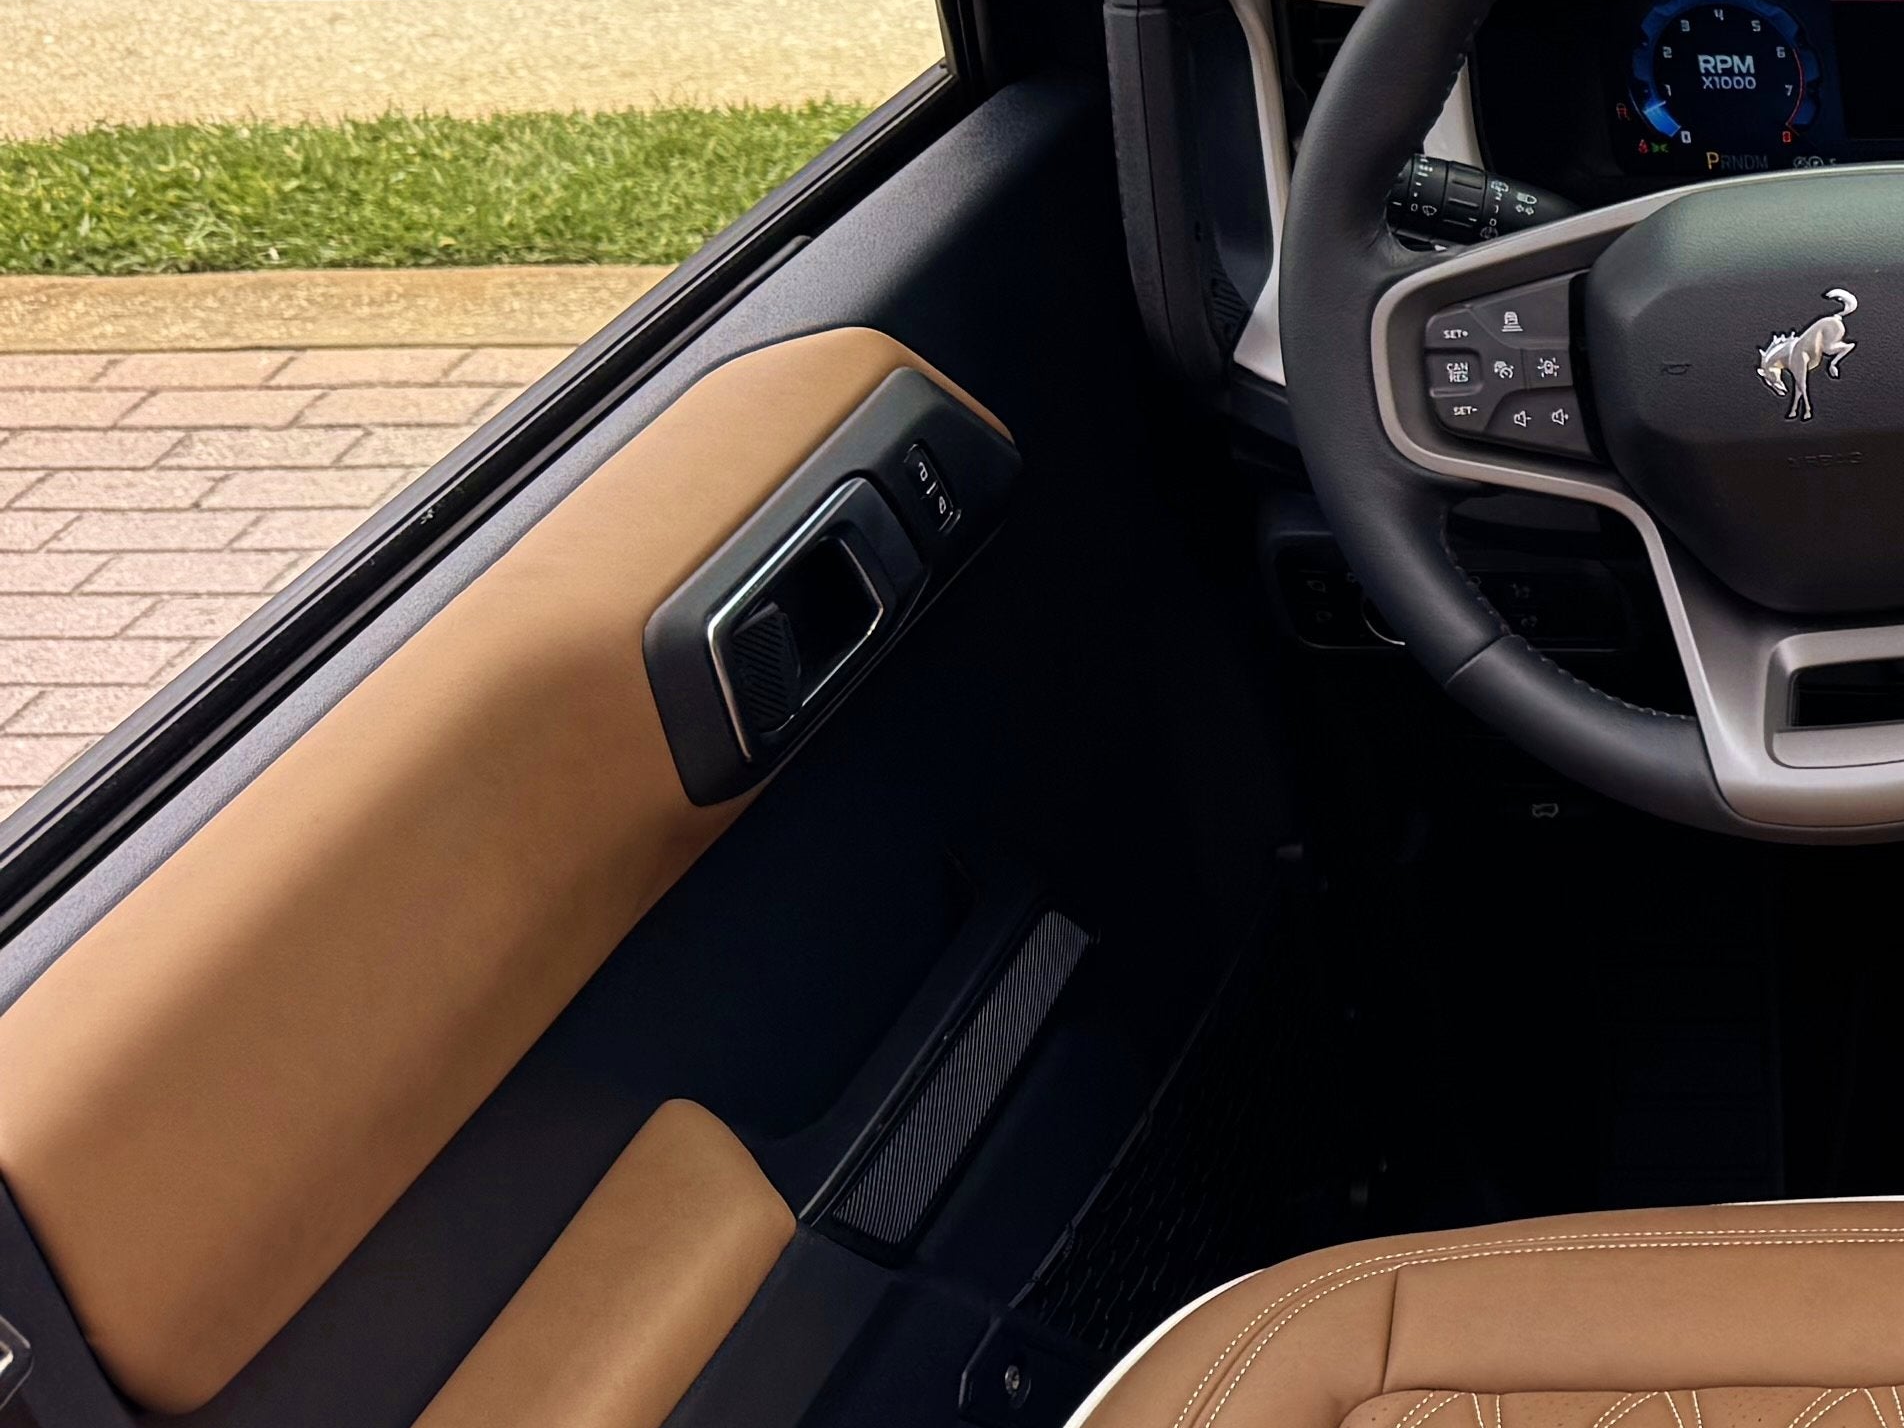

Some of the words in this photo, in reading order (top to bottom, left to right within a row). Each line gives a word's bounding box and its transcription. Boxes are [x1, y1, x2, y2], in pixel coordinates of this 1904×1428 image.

[1714, 9, 1724, 20] 4
[1681, 20, 1690, 32] 3
[1752, 20, 1761, 32] 5
[1663, 47, 1672, 58] 2
[1776, 47, 1785, 58] 6
[1698, 54, 1755, 74] RPM
[1703, 76, 1756, 90] X1000
[1665, 85, 1672, 96] 1
[1785, 85, 1793, 96] 7
[1681, 131, 1691, 143] 0
[1446, 363, 1469, 373] CAN
